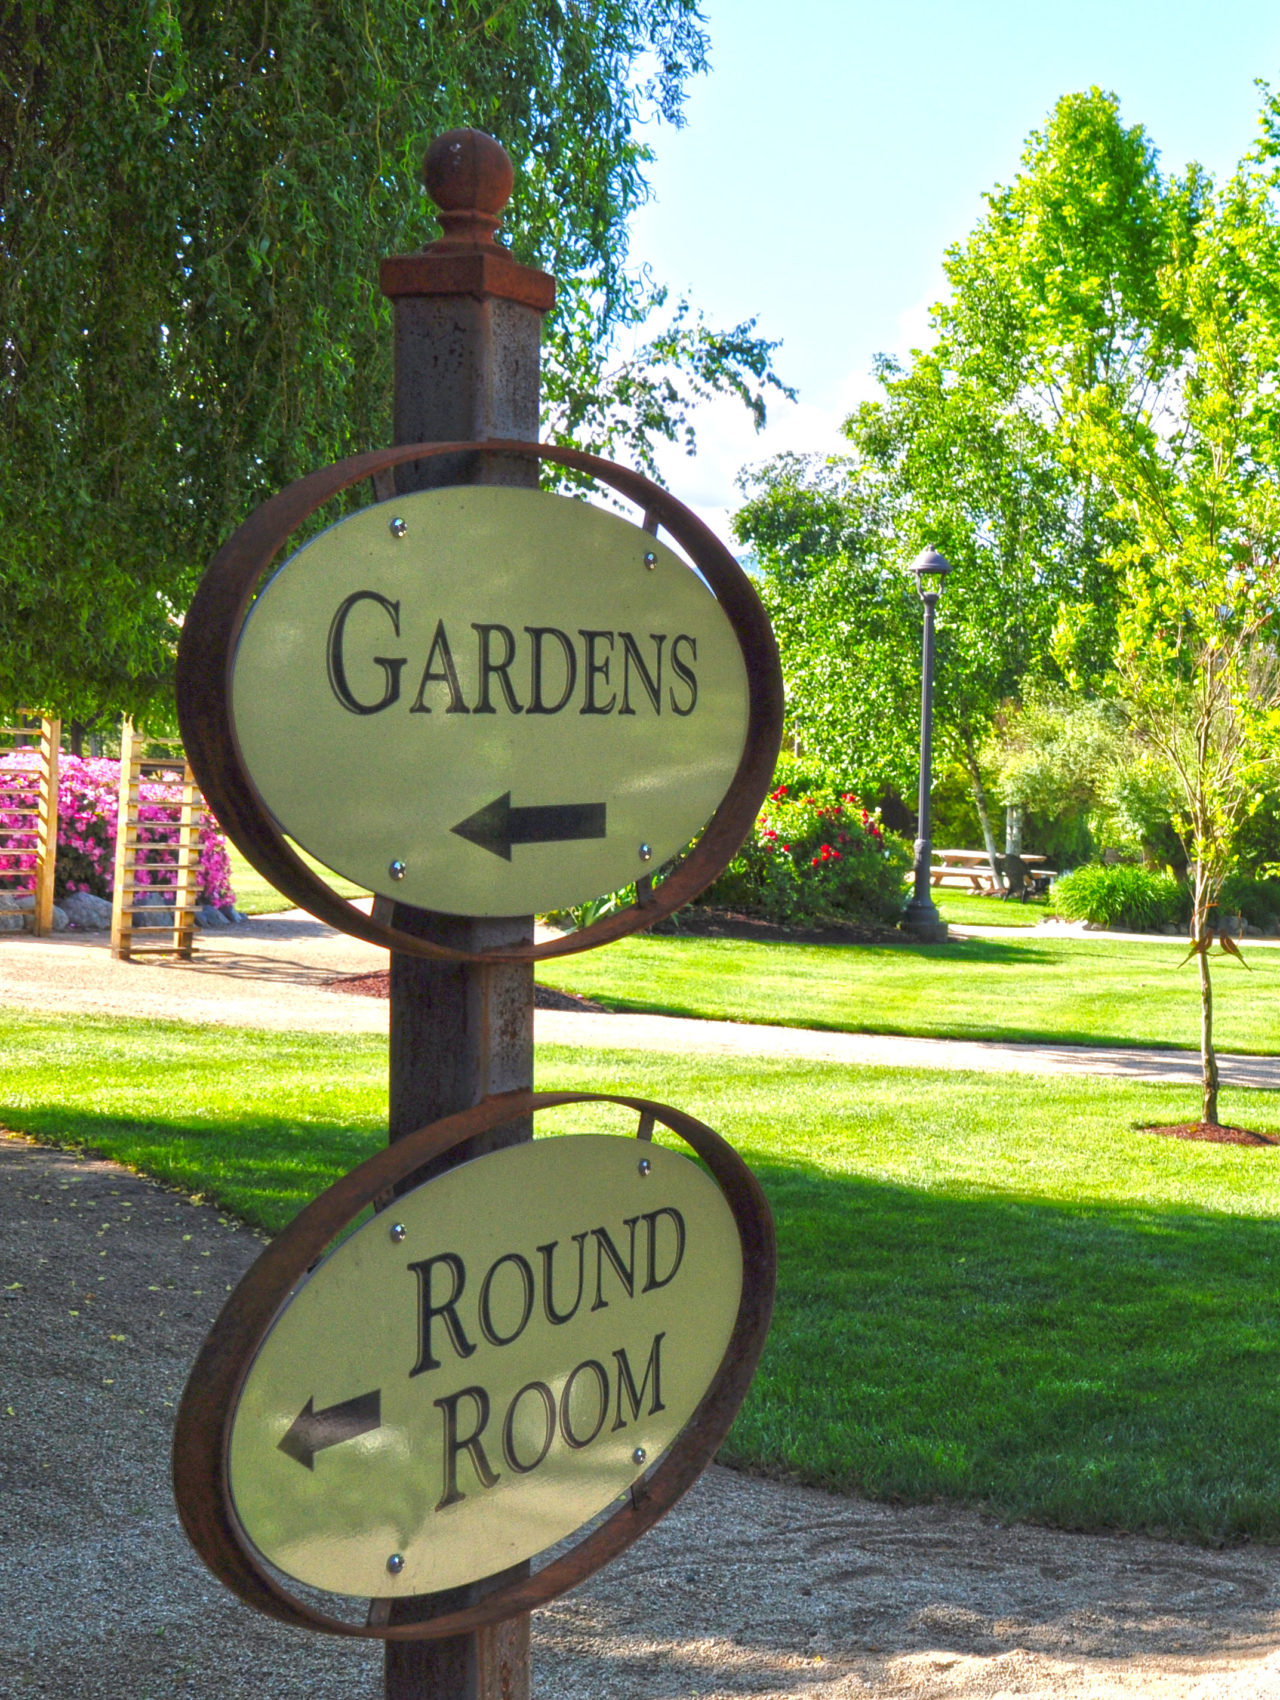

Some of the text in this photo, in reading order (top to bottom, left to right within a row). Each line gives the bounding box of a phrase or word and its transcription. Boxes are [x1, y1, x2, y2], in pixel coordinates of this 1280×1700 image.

[326, 590, 698, 717] GARDENS
[407, 1206, 687, 1379] ROUND
[433, 1331, 667, 1513] ROOM
